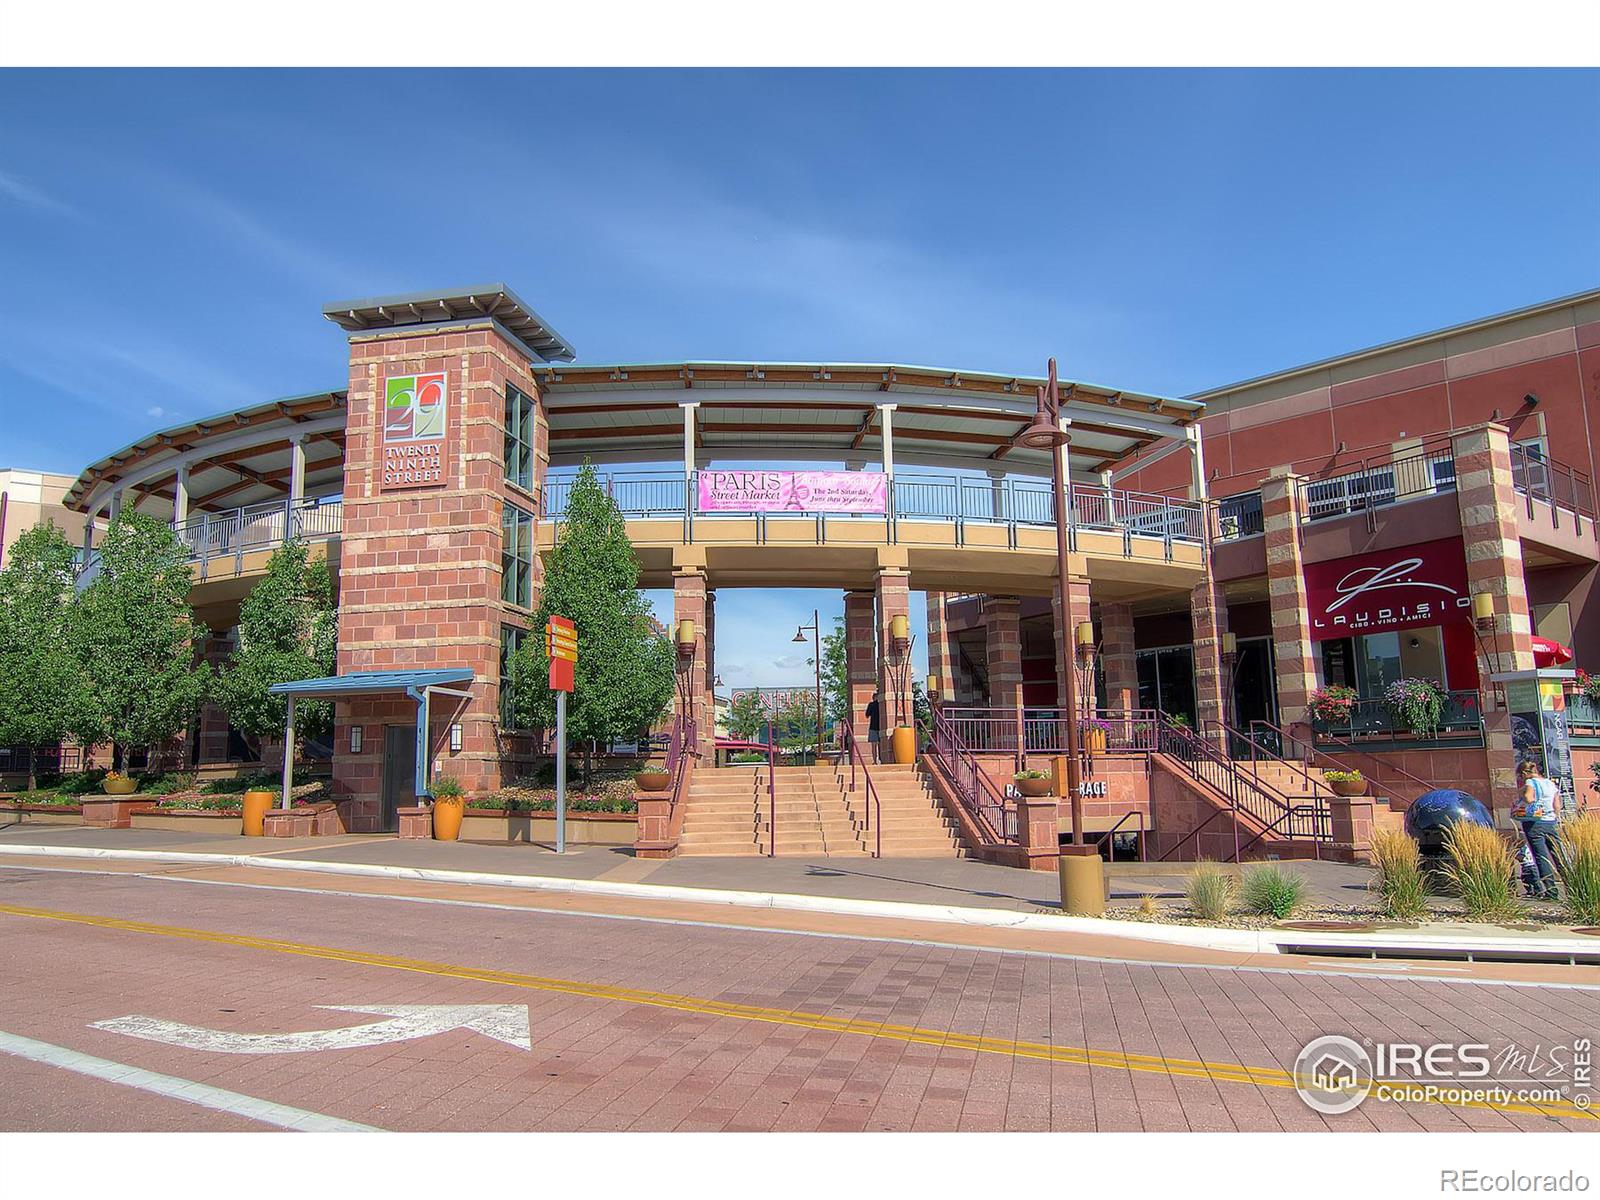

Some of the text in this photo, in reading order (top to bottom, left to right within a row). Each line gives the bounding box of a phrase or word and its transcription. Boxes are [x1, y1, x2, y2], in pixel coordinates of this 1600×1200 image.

[385, 444, 441, 458] TWENTY
[385, 457, 441, 471] NINTH
[384, 470, 441, 484] STREET
[711, 473, 781, 490] PARIS
[711, 490, 780, 500] Street Market
[1314, 597, 1471, 628] LAUDISIO
[1377, 617, 1397, 625] VINO
[1406, 613, 1431, 621] AMICI
